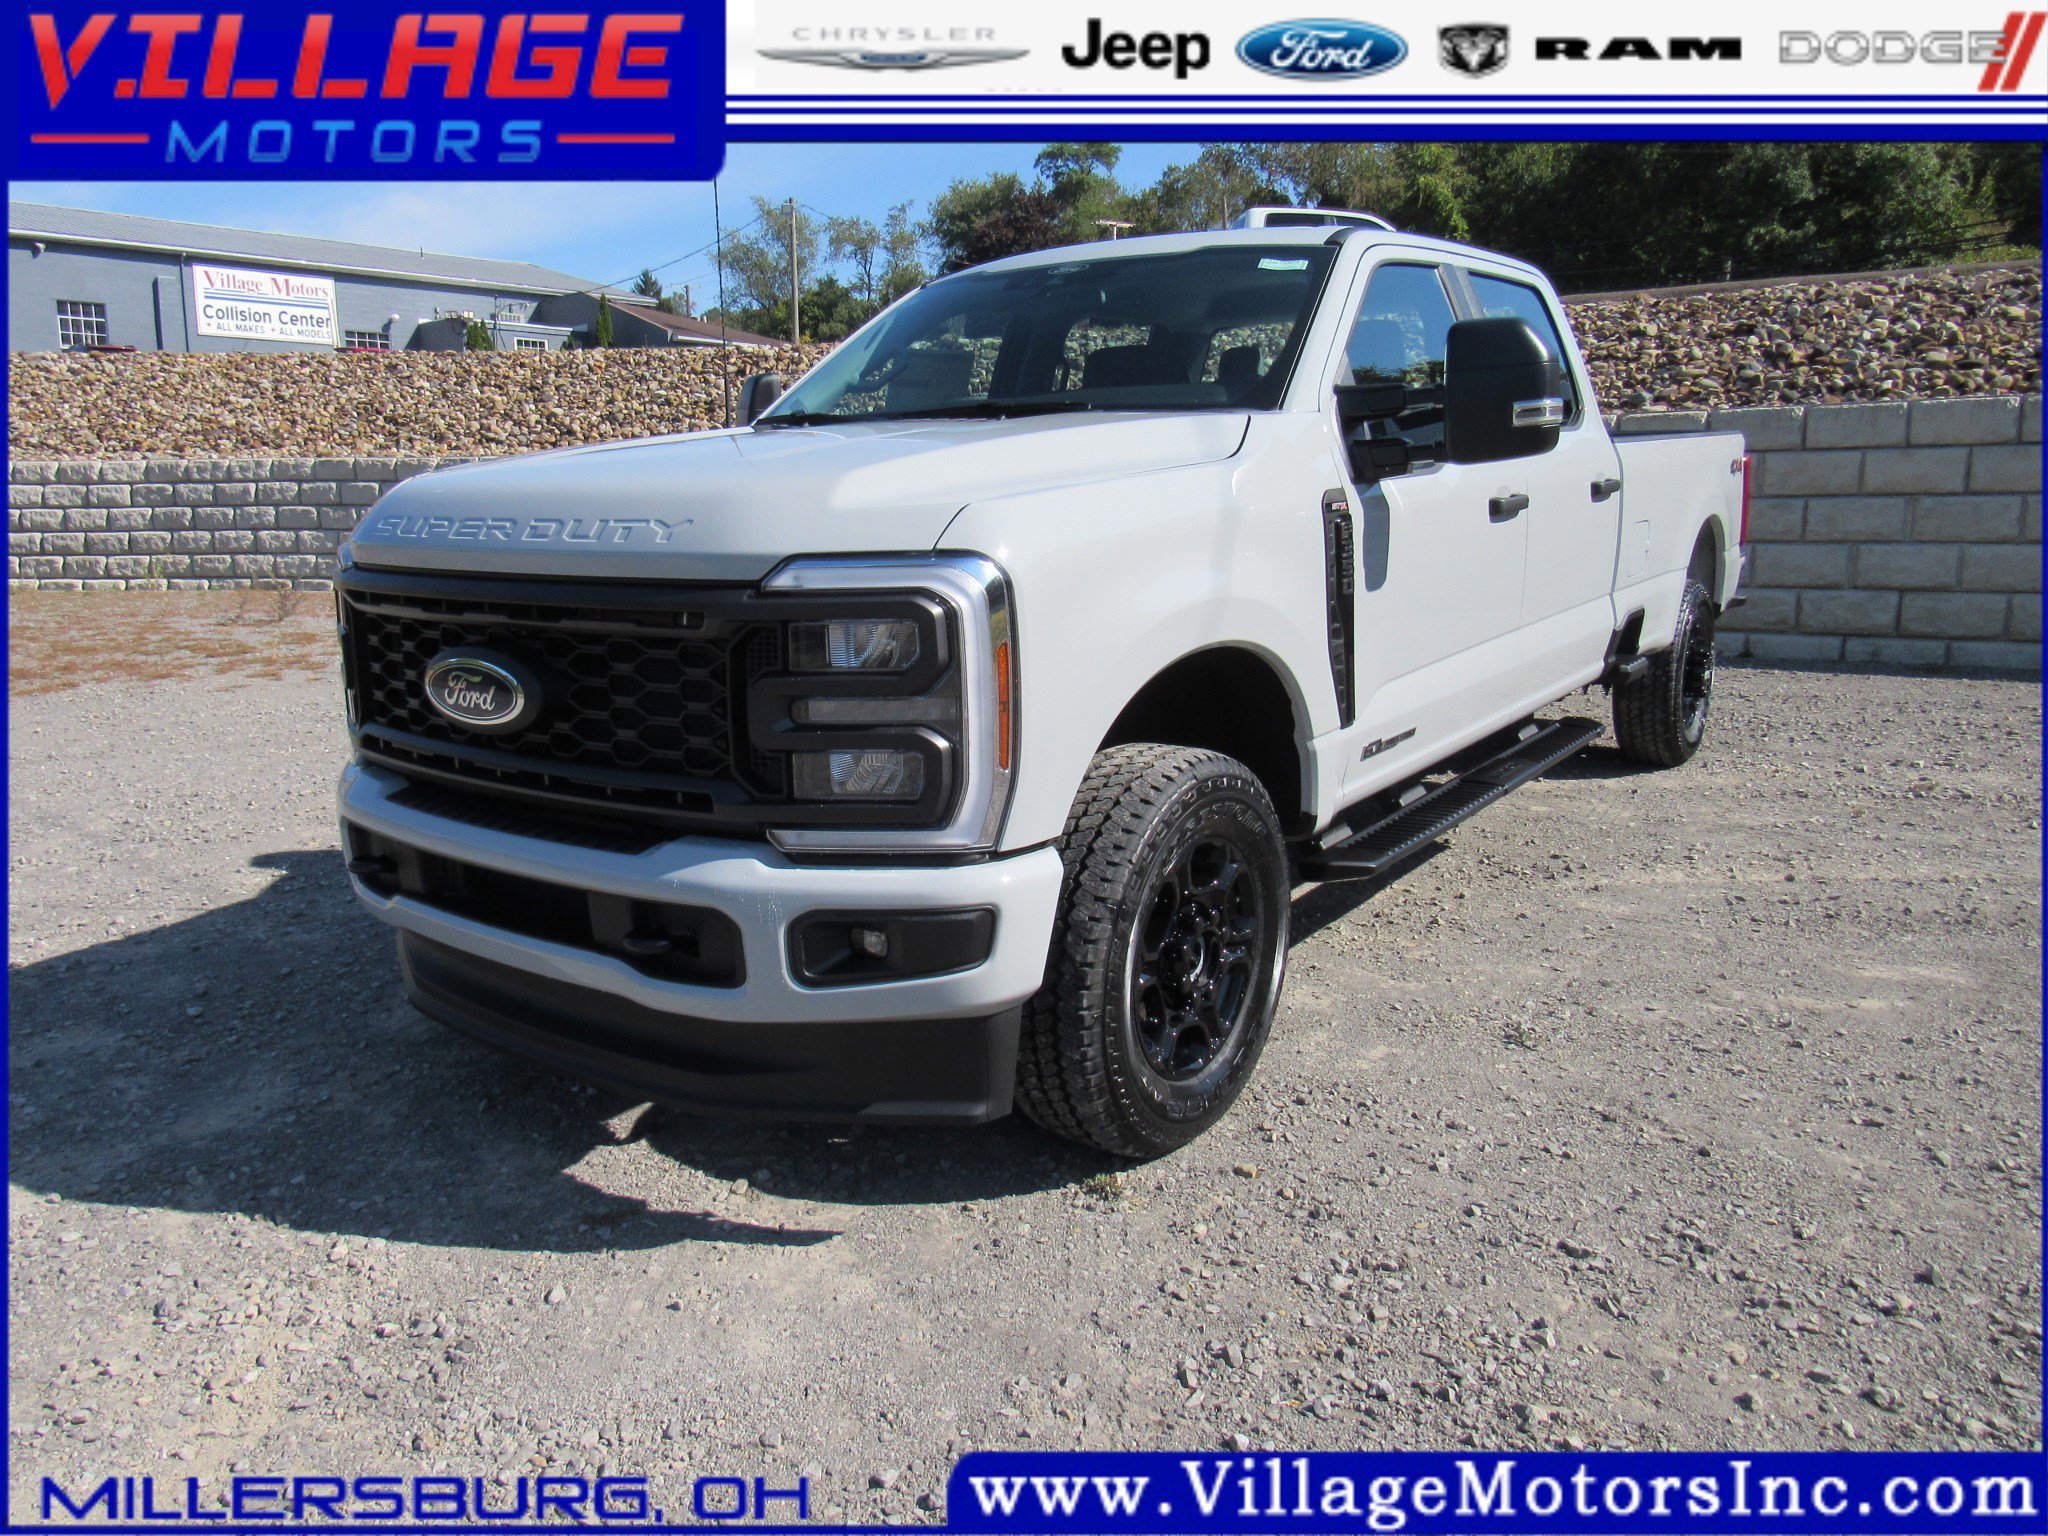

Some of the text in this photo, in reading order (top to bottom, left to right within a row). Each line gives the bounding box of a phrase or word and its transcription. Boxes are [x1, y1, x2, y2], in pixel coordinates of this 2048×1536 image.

[203, 270, 329, 298] Village Motors
[203, 304, 331, 329] Collision Center
[216, 322, 332, 339] ALL MAKES ALL MODELS
[374, 515, 695, 544] SUPER DUTY
[445, 671, 496, 711] Ford
